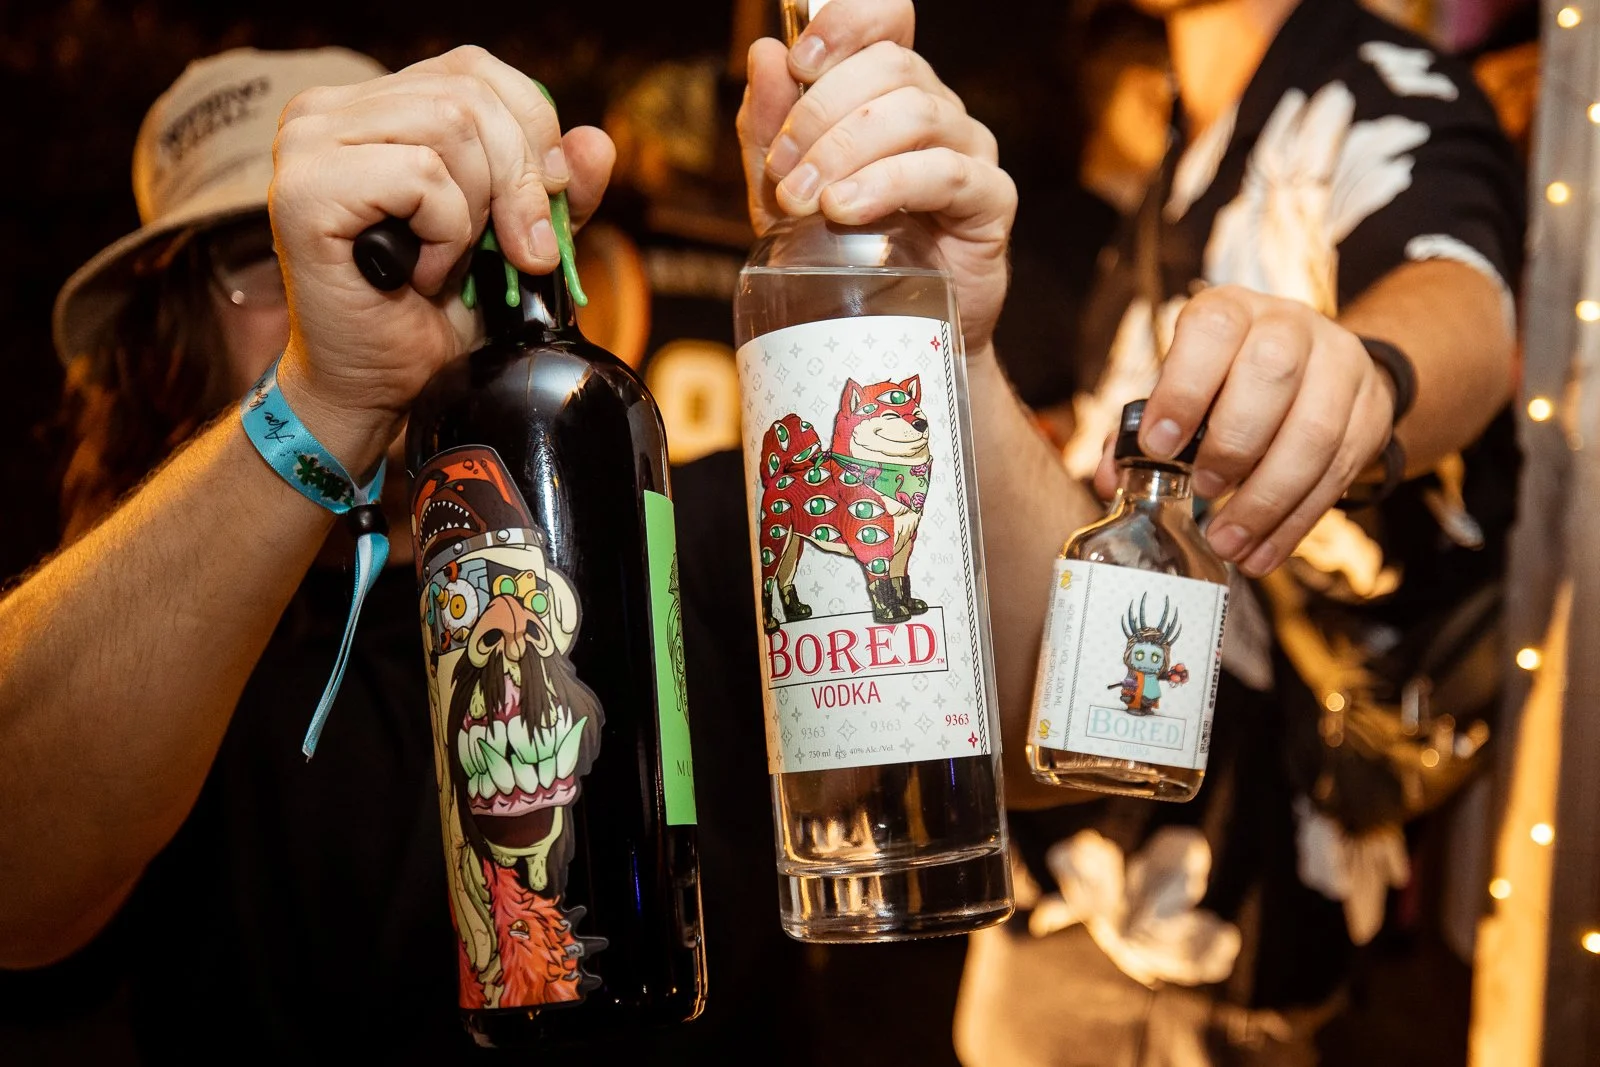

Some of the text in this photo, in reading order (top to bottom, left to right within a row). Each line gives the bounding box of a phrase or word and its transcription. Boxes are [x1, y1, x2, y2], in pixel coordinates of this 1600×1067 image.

[767, 623, 939, 682] BORED
[811, 681, 882, 709] VODKA
[870, 719, 901, 733] 9363
[945, 714, 970, 727] 9363
[1090, 708, 1180, 746] BORED
[801, 726, 826, 740] 9363
[808, 751, 821, 759] 750
[822, 749, 831, 758] ml
[849, 748, 864, 756] 40%
